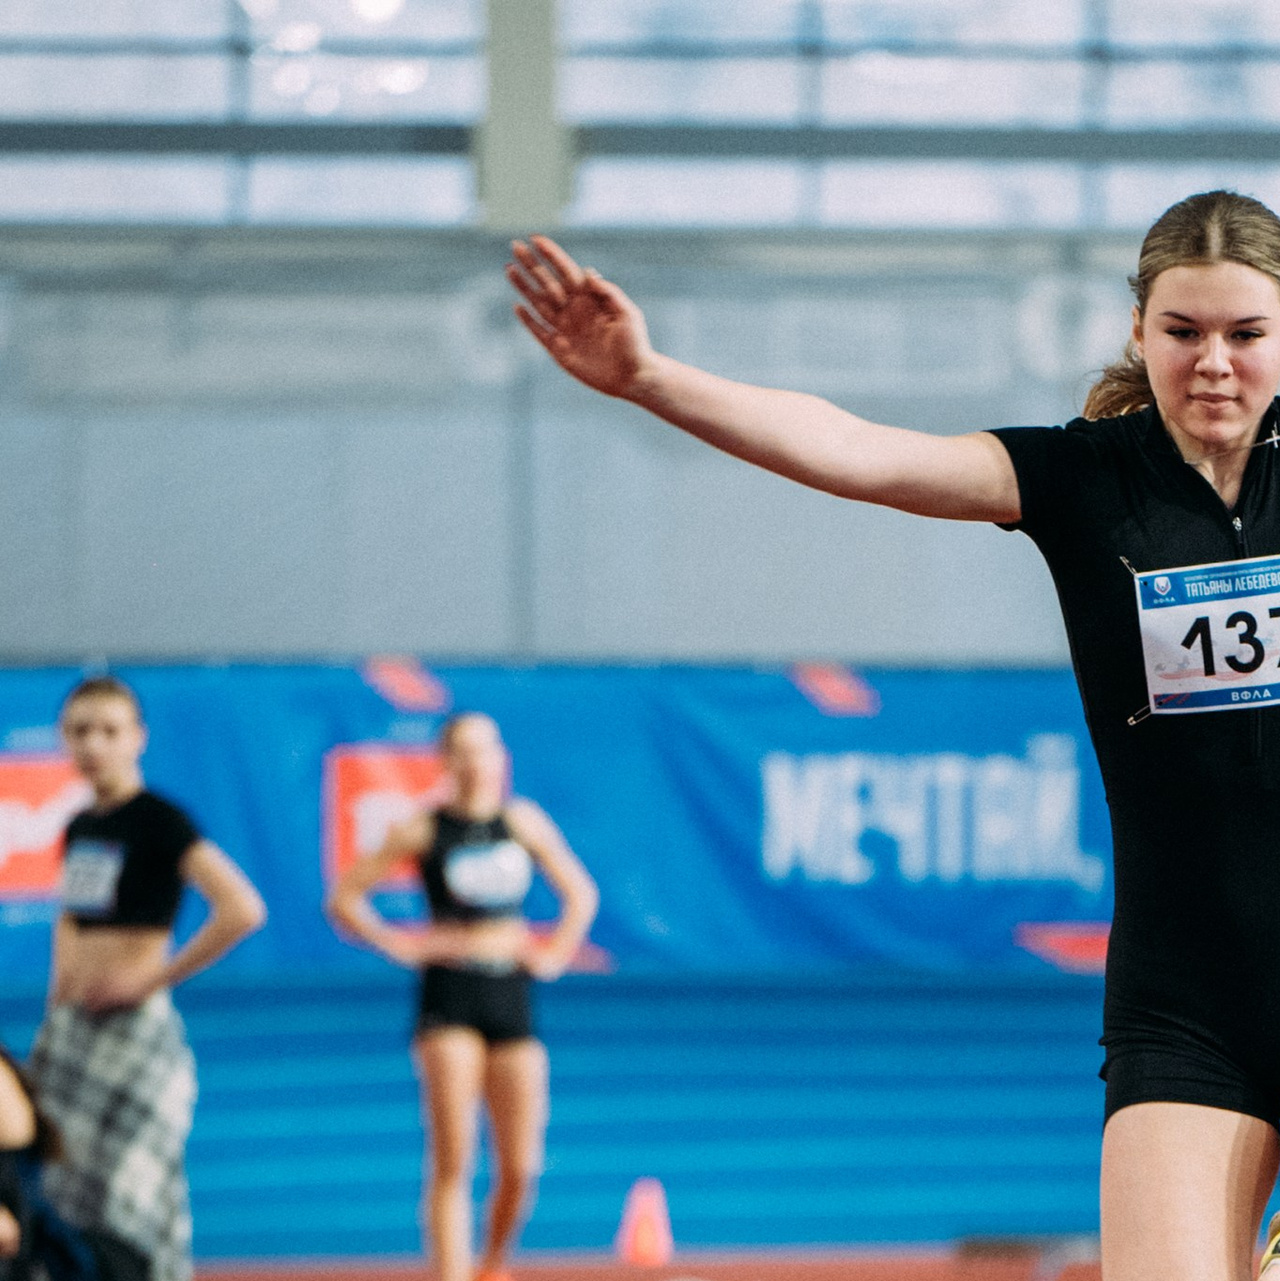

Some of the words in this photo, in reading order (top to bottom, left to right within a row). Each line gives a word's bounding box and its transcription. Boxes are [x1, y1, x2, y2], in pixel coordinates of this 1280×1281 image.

[1185, 578, 1233, 598] ТАТЬЯНЫ
[1231, 688, 1272, 701] ВФЛА
[760, 734, 1104, 893] МЕЧТАЙ,
